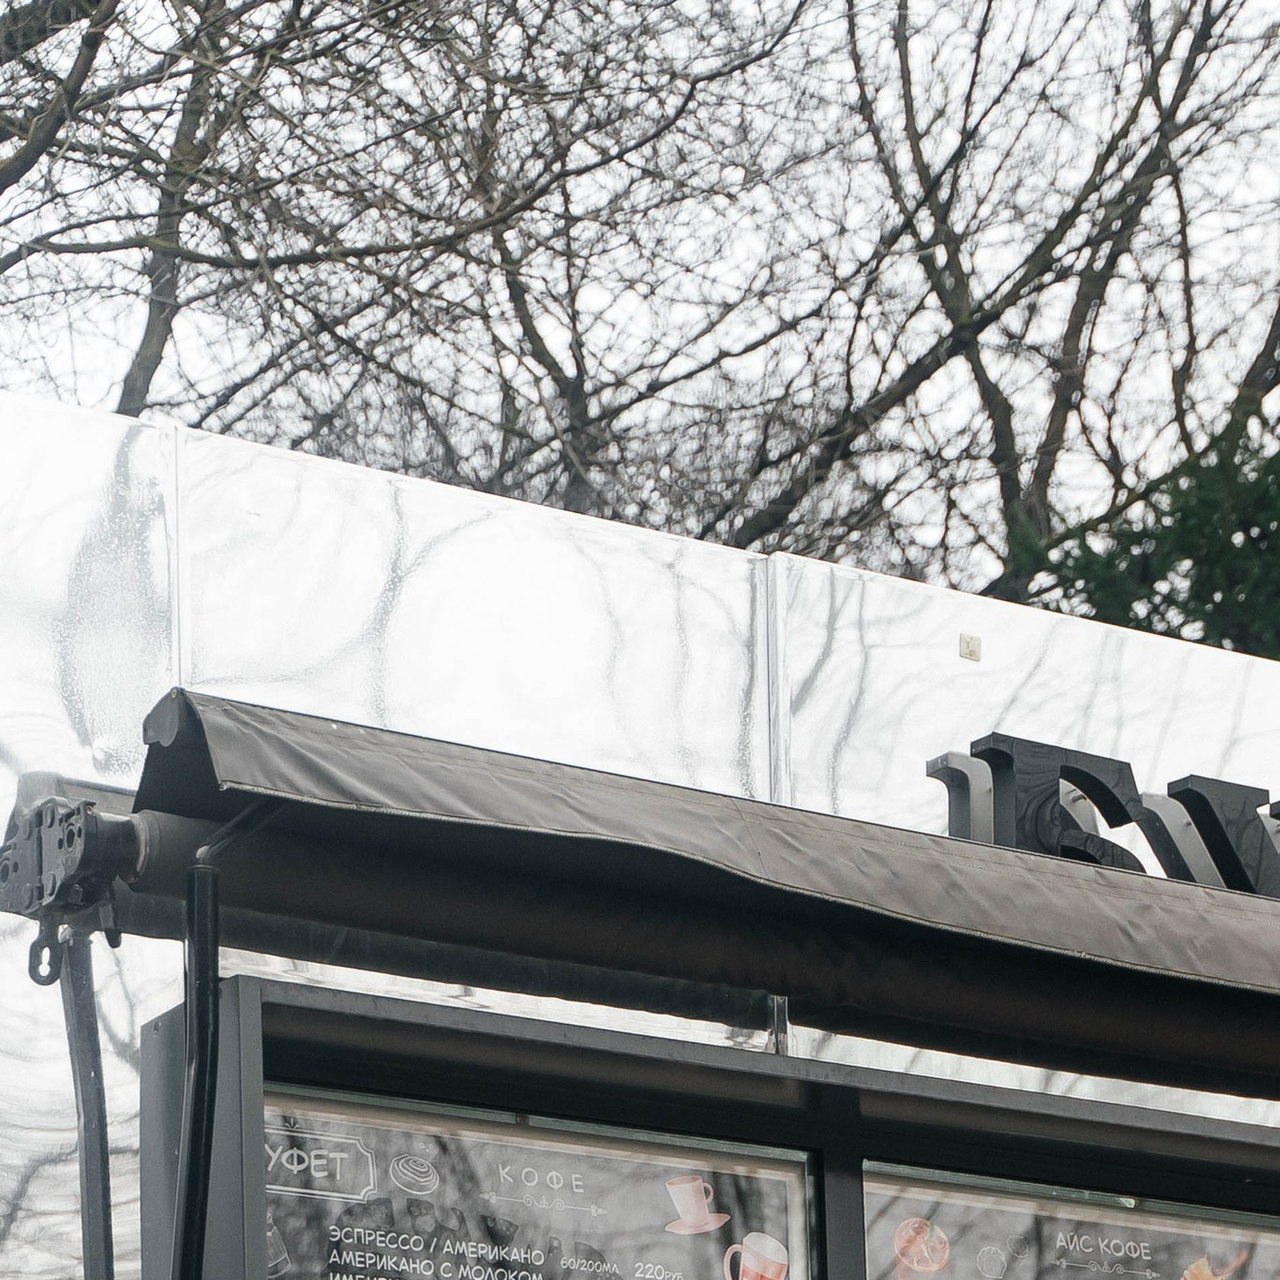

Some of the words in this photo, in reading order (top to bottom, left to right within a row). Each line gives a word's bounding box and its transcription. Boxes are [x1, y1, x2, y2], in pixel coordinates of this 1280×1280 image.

[265, 1143, 349, 1180] УФЕТ
[498, 1163, 585, 1193] КОФЕ
[328, 1225, 424, 1251] ЭСПРЕССО
[443, 1238, 545, 1266] АМЕРИКАНО
[560, 1256, 619, 1274] 60/200МЛ
[1056, 1232, 1094, 1252] АЙС
[1098, 1237, 1152, 1260] КОФЕ
[329, 1249, 434, 1276] АМЕРИКАНО
[440, 1262, 453, 1278] С
